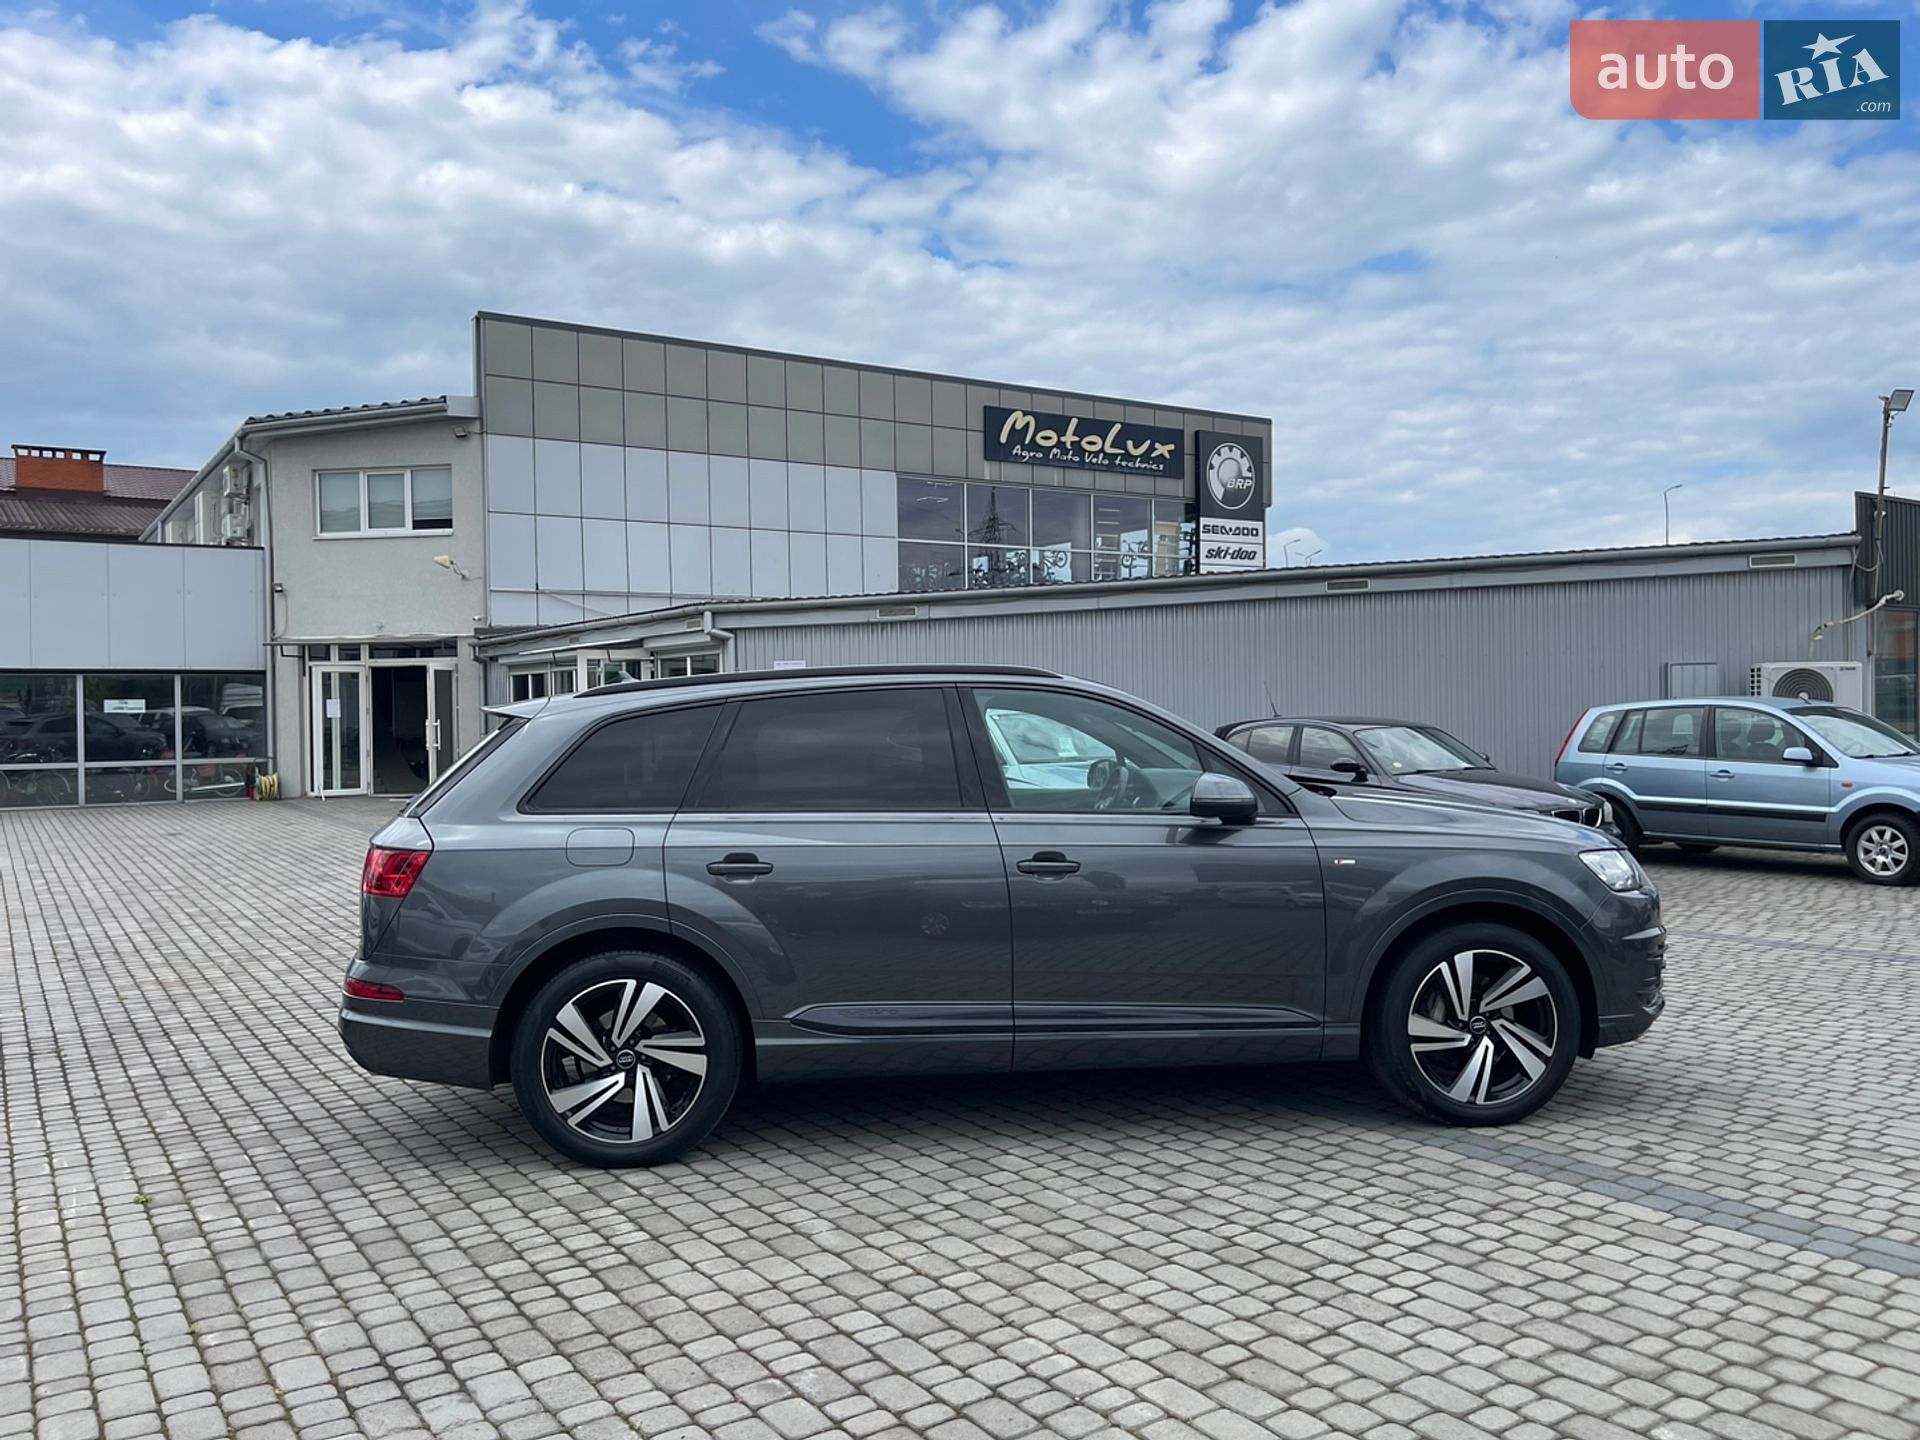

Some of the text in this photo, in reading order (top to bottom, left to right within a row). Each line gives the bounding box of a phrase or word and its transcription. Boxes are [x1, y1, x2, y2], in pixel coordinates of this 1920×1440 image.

[1012, 445, 1164, 471] Agro Moto Velo technics
[1226, 478, 1253, 490] BRP
